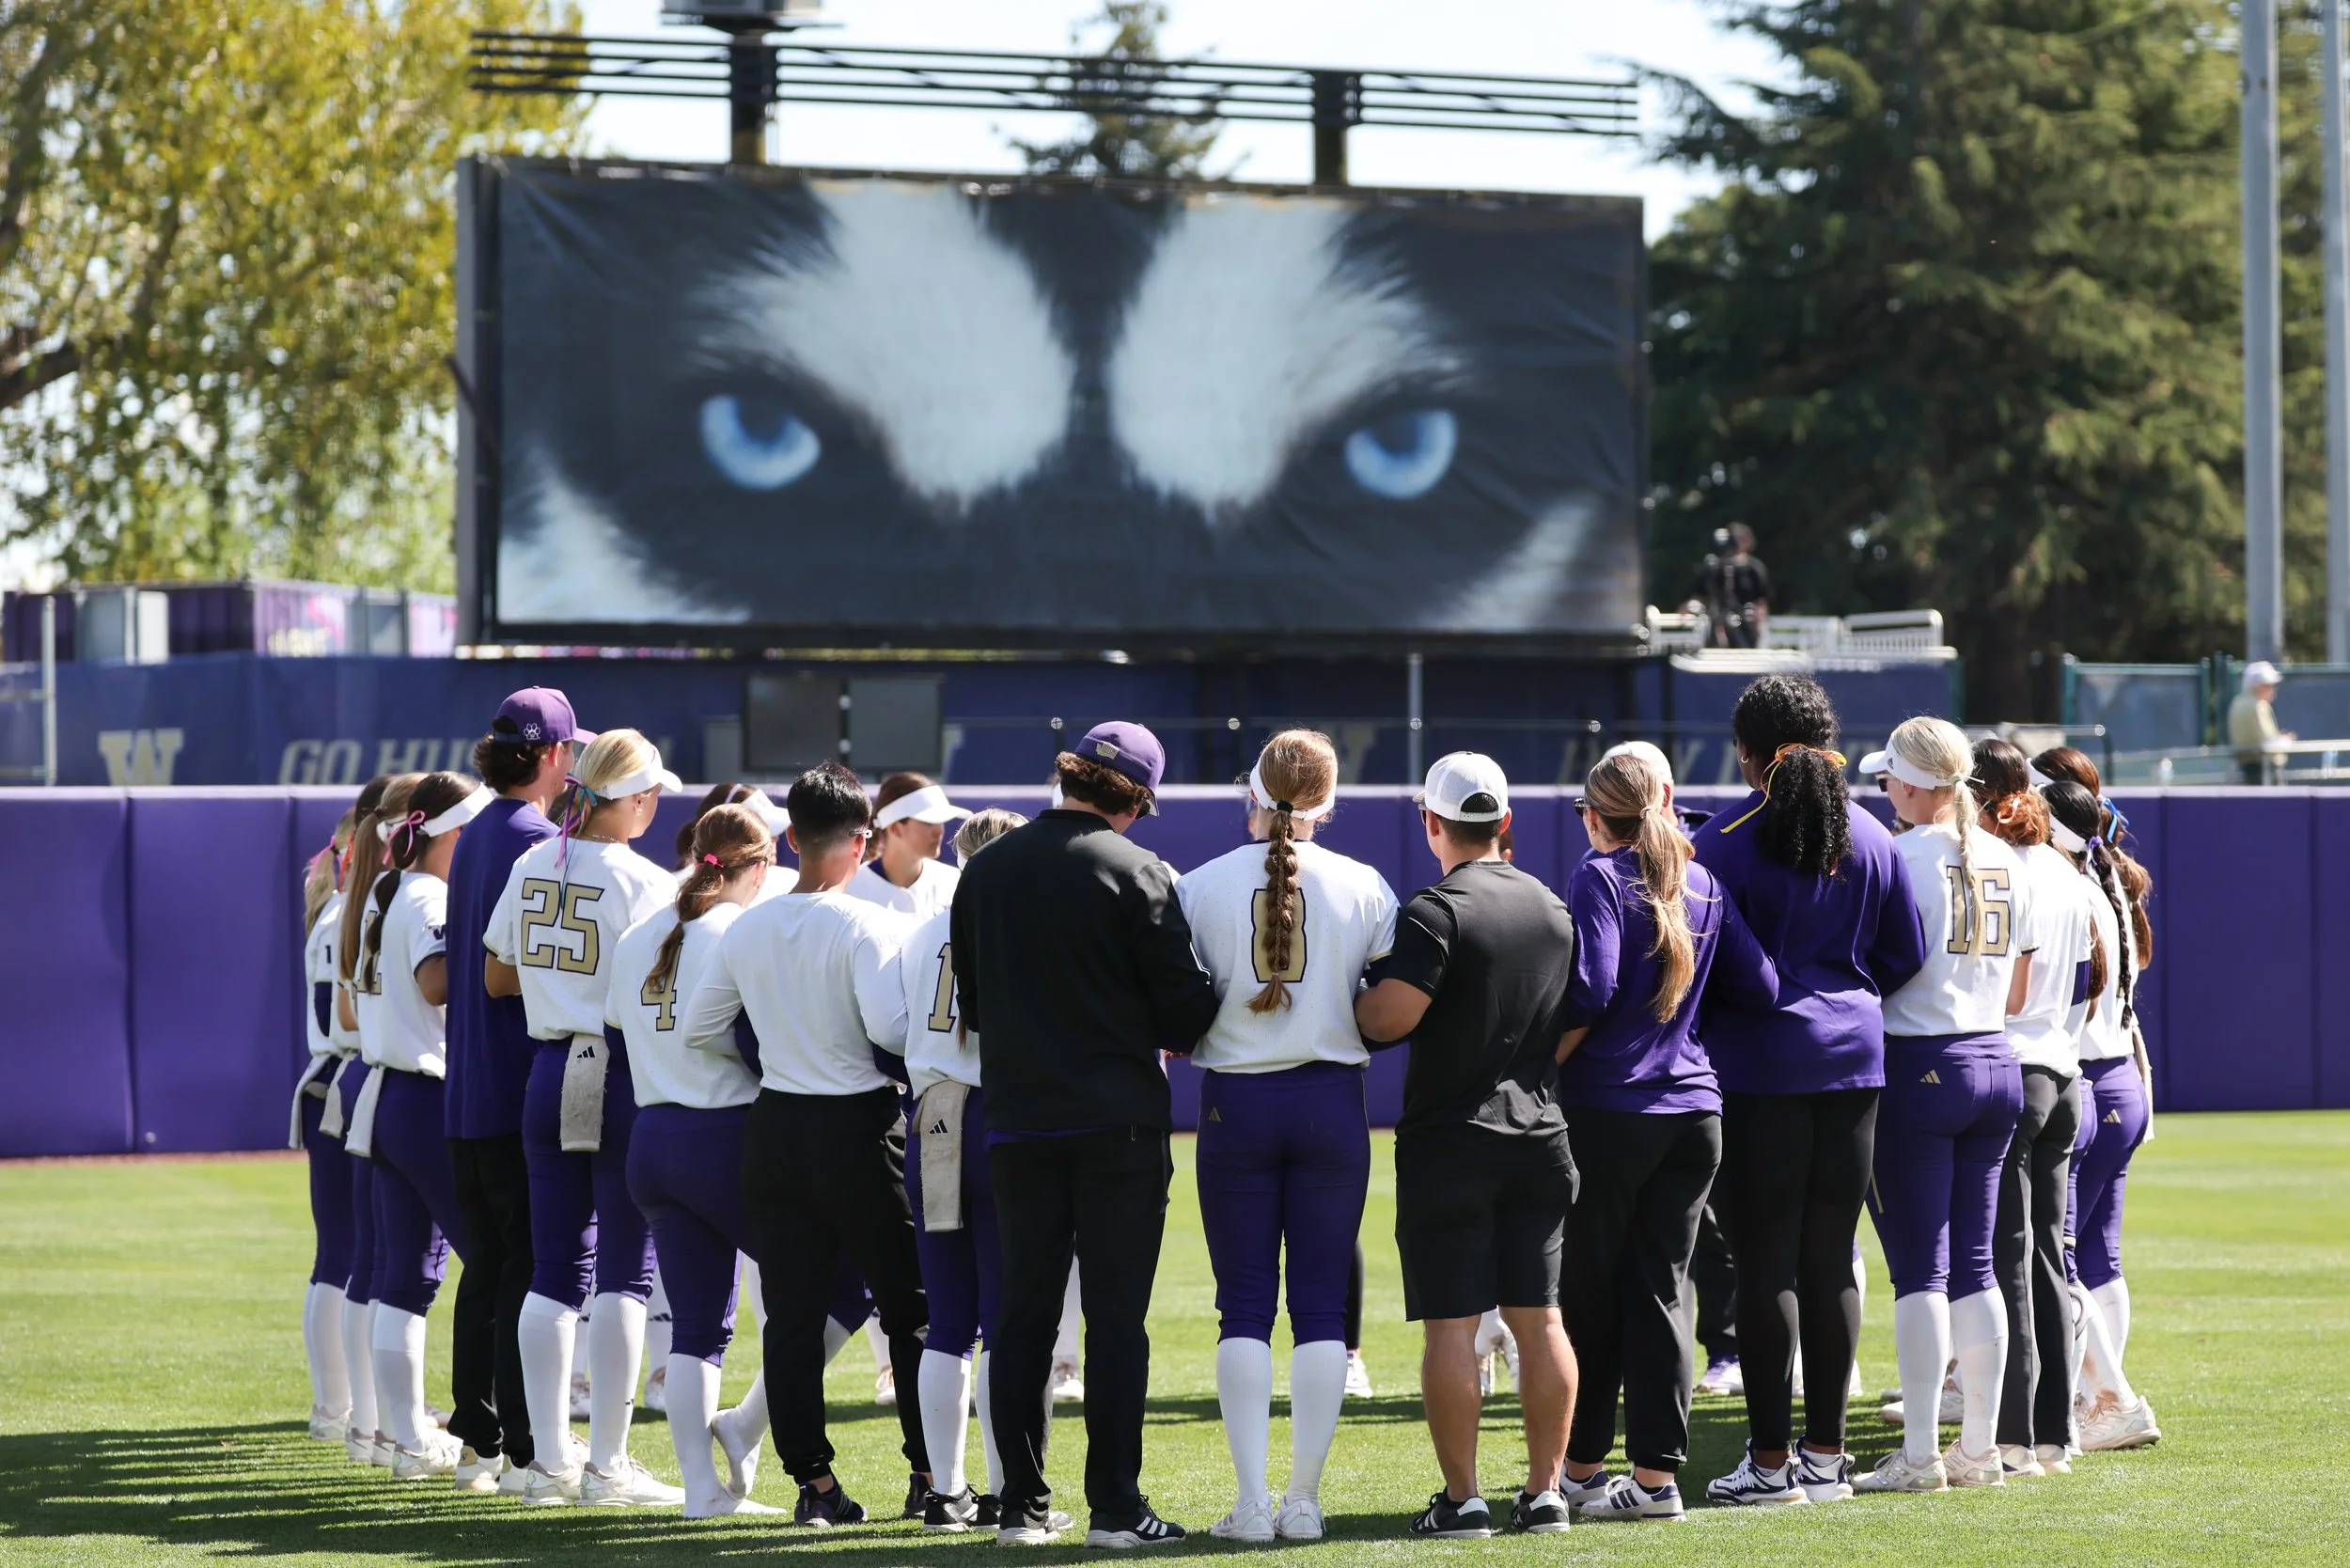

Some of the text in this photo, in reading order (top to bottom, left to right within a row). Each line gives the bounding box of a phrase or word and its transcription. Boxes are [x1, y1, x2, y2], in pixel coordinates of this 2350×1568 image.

[98, 728, 183, 786] W
[278, 739, 363, 785] GO
[521, 877, 604, 976] 25
[1946, 865, 2011, 957] 16
[640, 942, 678, 1032] 4
